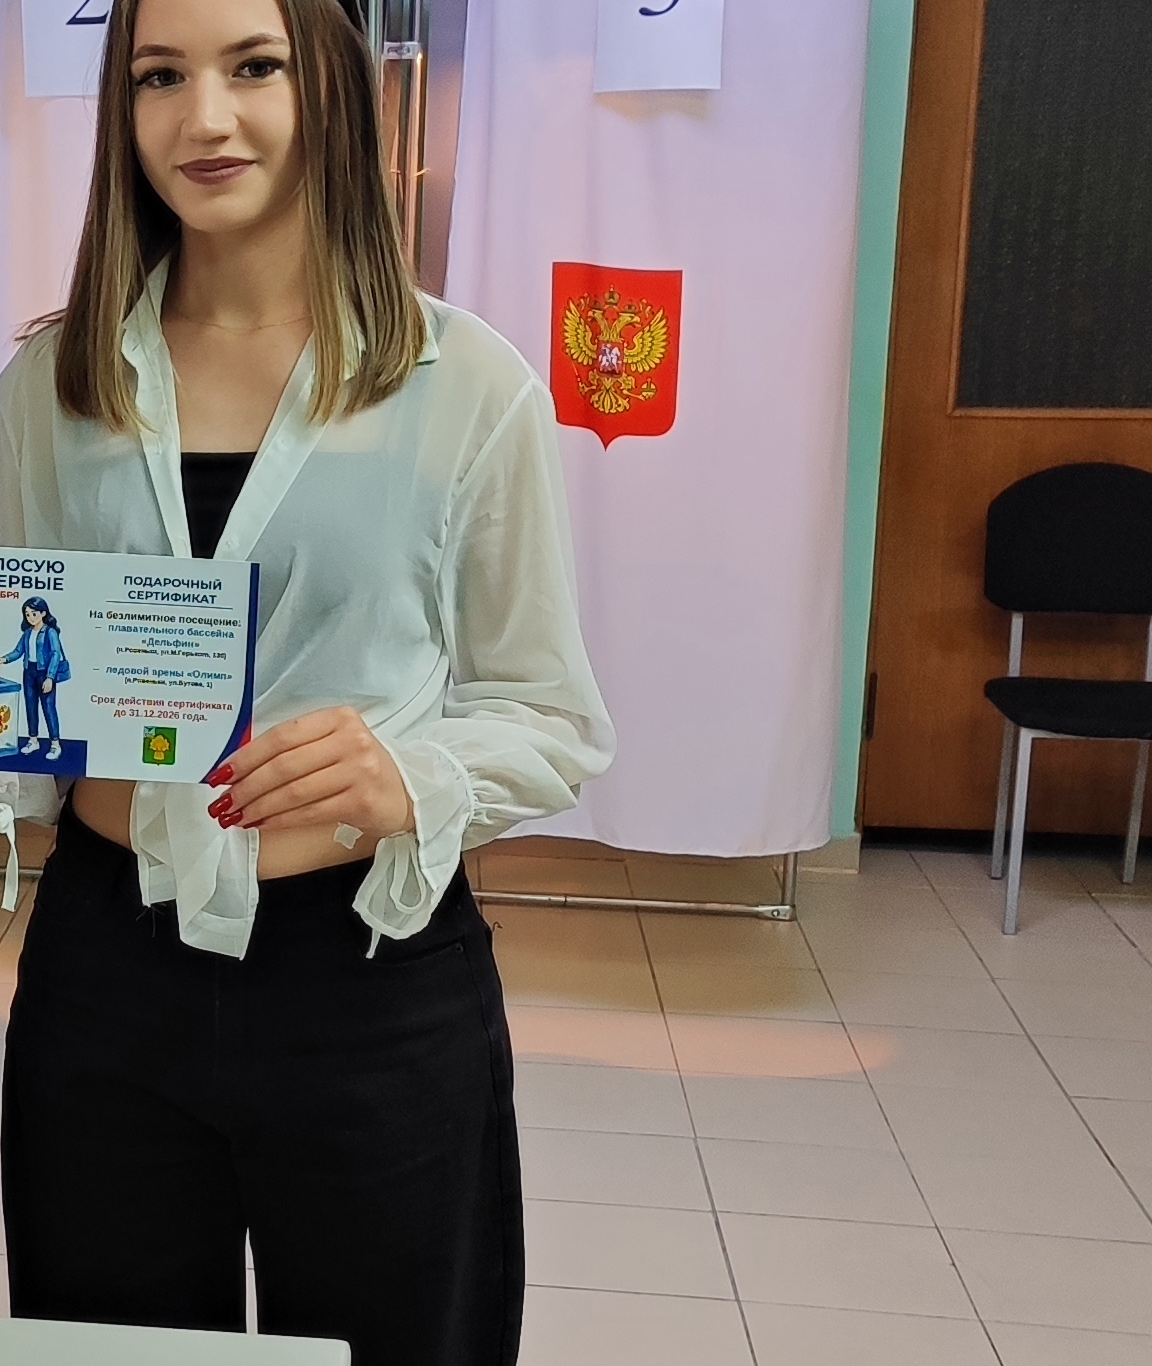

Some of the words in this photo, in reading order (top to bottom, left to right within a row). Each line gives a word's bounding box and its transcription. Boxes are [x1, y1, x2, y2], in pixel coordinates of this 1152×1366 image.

[123, 575, 223, 591] ПОДАРОЧНЫЙ
[127, 590, 218, 605] СЕРТИФИКАТ
[89, 610, 104, 620] На
[106, 610, 176, 624] безлимитное
[178, 616, 242, 628] посещение:
[108, 624, 185, 636] плавательного
[186, 627, 235, 639] бассейна
[141, 637, 200, 648] «Дельфин»
[105, 666, 149, 676] ледовой
[186, 670, 233, 681] «Олимп»
[90, 694, 116, 705] Срок
[117, 696, 165, 708] действия
[167, 700, 234, 712] сертификата
[113, 709, 127, 718] до
[182, 713, 208, 723] года.
